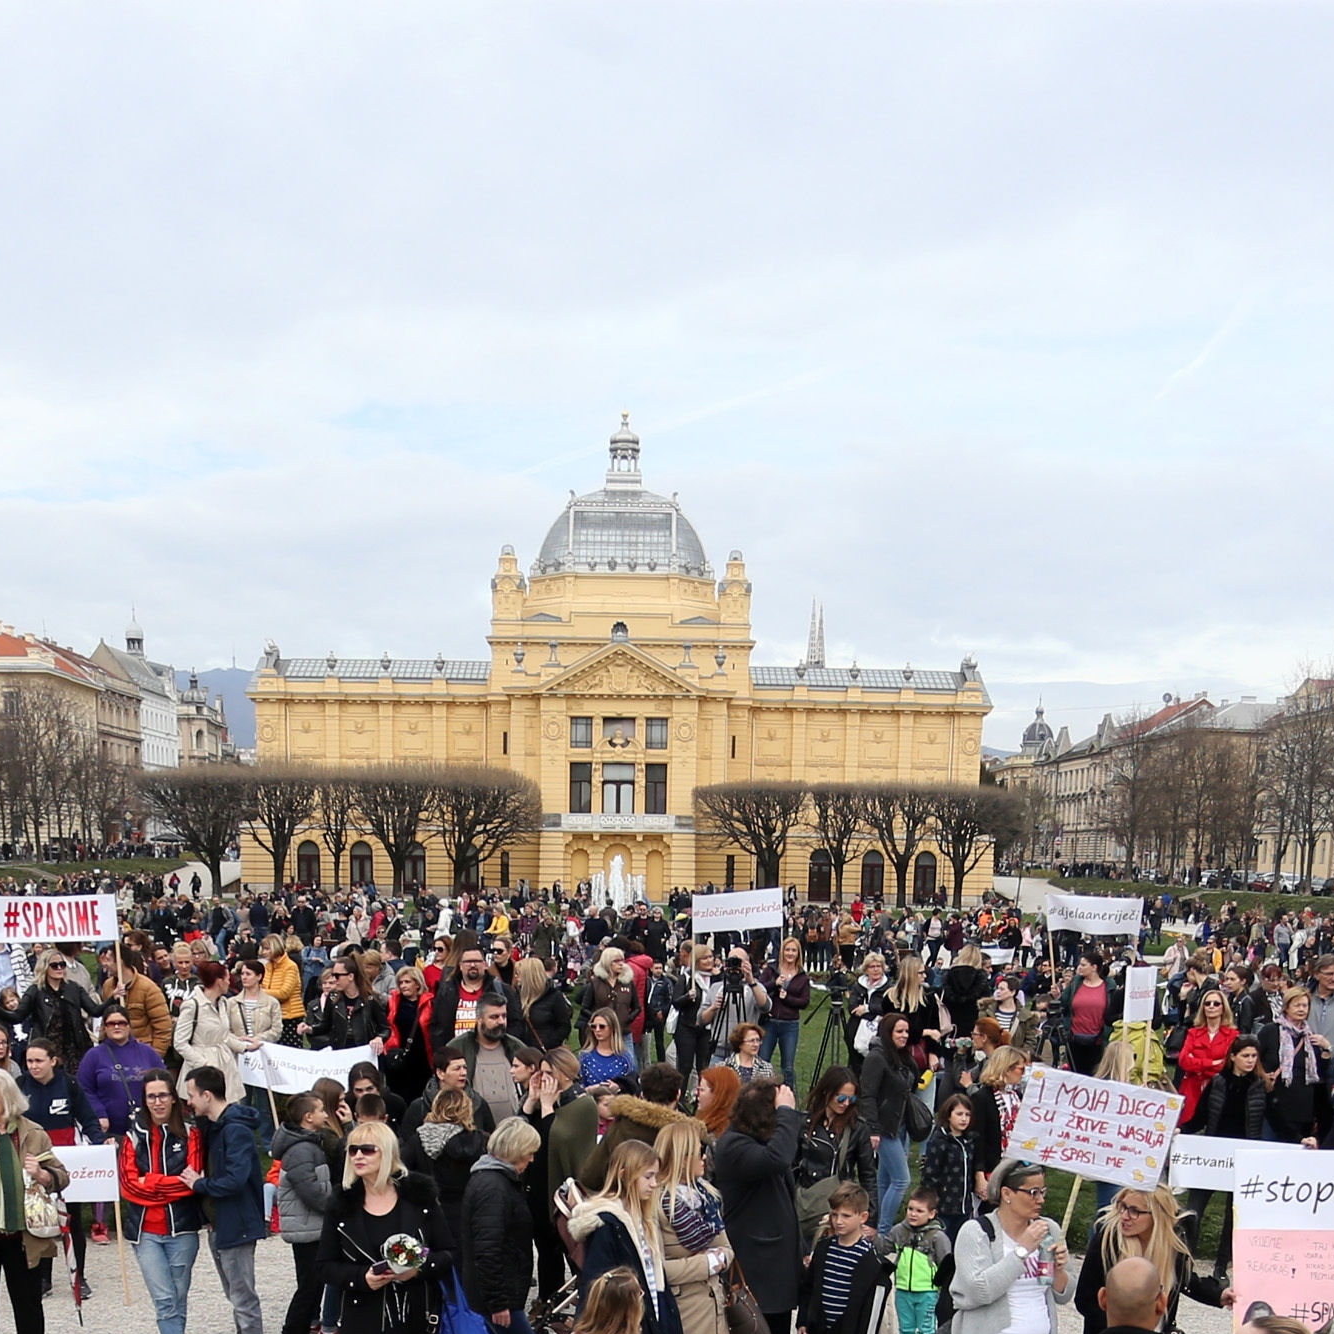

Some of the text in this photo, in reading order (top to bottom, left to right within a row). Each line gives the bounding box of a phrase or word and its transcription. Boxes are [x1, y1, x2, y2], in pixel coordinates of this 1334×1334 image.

[4, 900, 101, 938] #SPASIME
[693, 902, 784, 918] #zločinaneprekrša
[1048, 906, 1140, 924] #djelaaneriječi
[1038, 1078, 1167, 1120] I MOJA DJECA
[1029, 1107, 1057, 1123] SU
[1065, 1111, 1109, 1134] ŽRTVE
[1060, 1147, 1096, 1165] SPASI
[1106, 1156, 1125, 1168] ME
